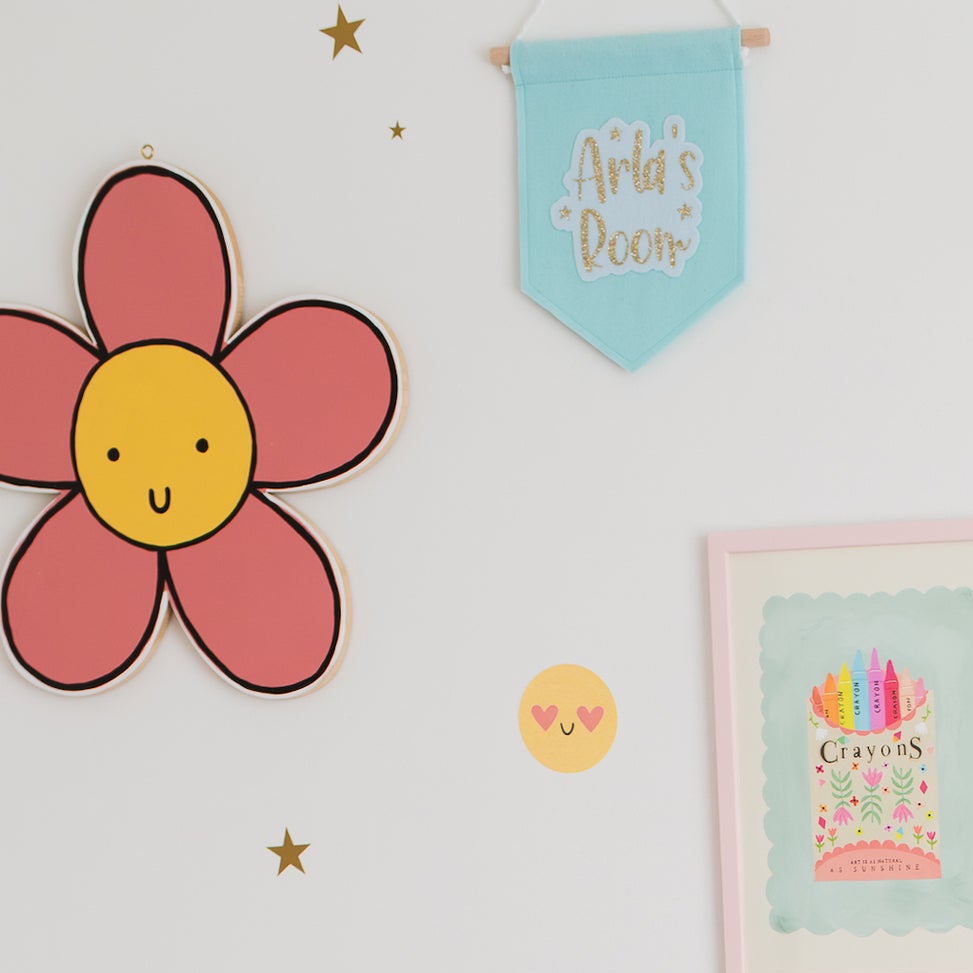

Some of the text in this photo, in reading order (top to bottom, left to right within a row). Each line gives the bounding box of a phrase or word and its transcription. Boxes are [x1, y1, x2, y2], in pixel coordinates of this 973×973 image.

[573, 124, 697, 204] Arla's
[580, 207, 691, 272] Room
[853, 682, 861, 716] CRAYON
[873, 680, 882, 714] CRAYON
[853, 863, 920, 873] SUNSHINE
